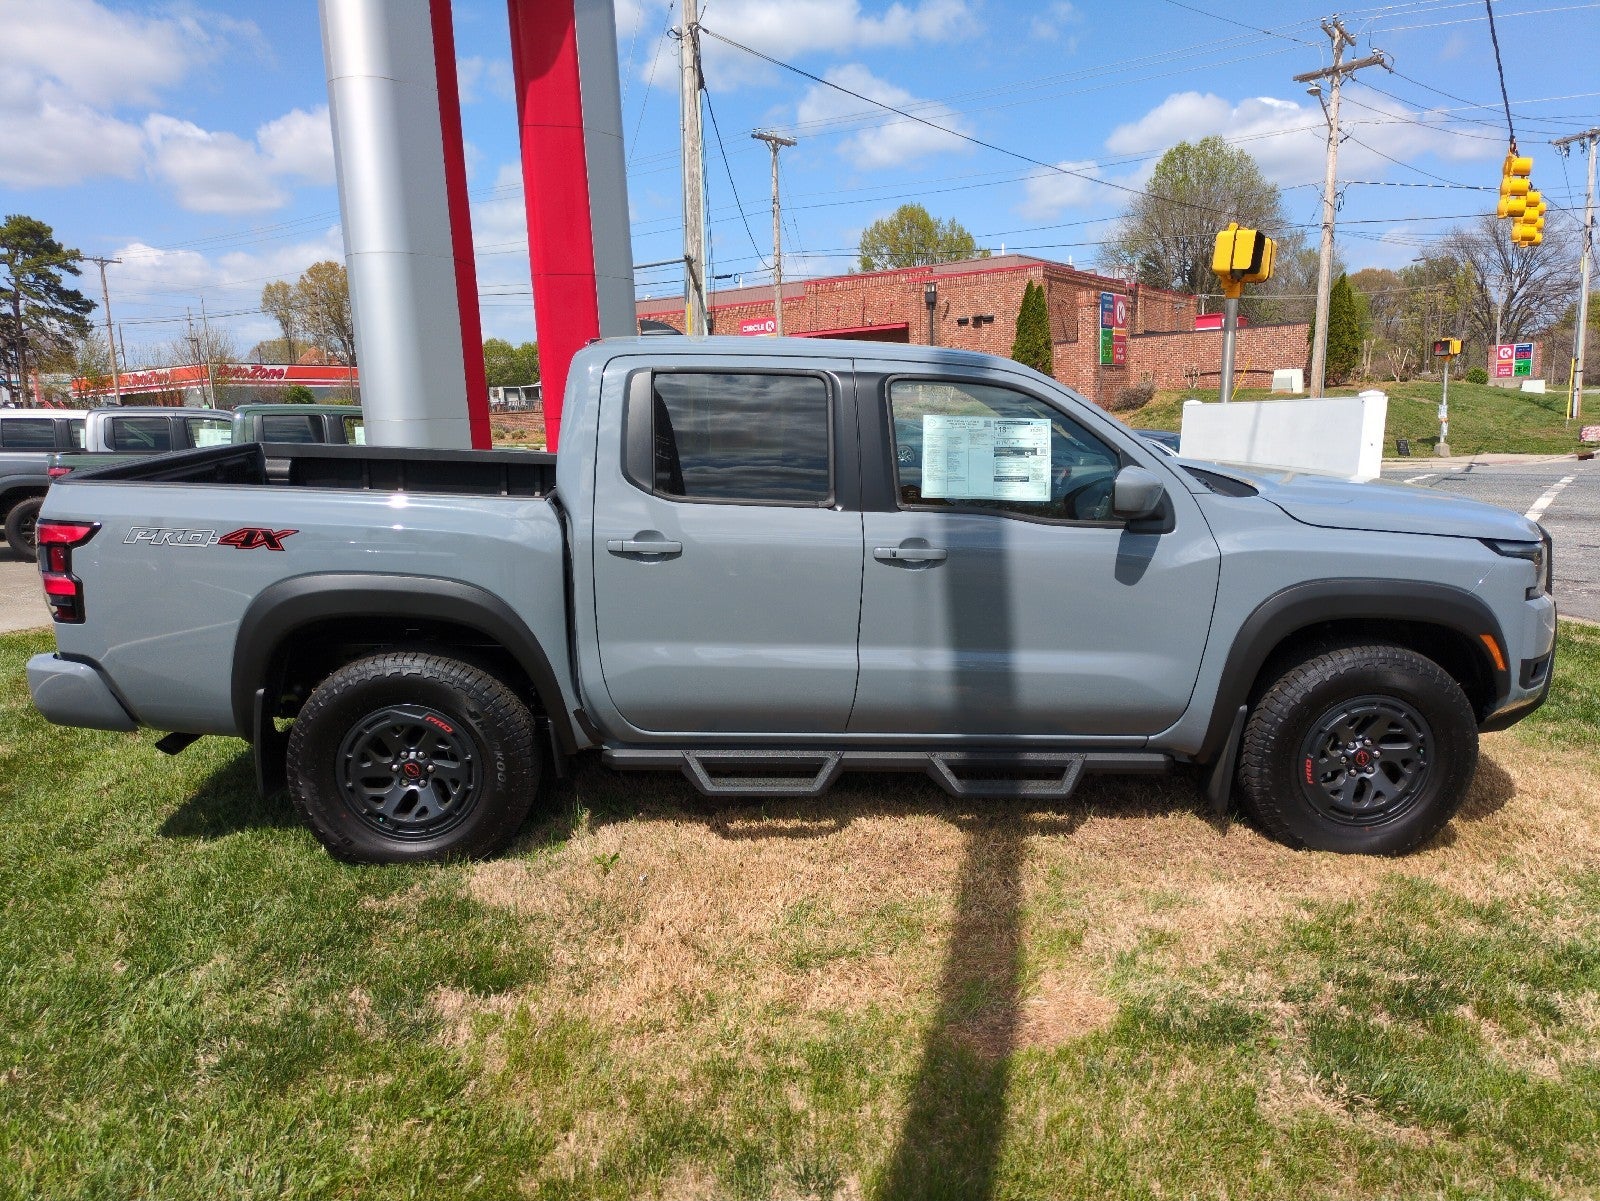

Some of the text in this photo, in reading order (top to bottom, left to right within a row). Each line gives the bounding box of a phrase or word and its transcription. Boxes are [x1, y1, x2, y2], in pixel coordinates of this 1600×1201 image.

[1118, 304, 1124, 322] K
[742, 322, 774, 332] CIRCLE K
[1502, 349, 1510, 358] K
[217, 364, 284, 379] AutoZone
[424, 714, 455, 734] PRO
[1304, 758, 1314, 784] PRO
